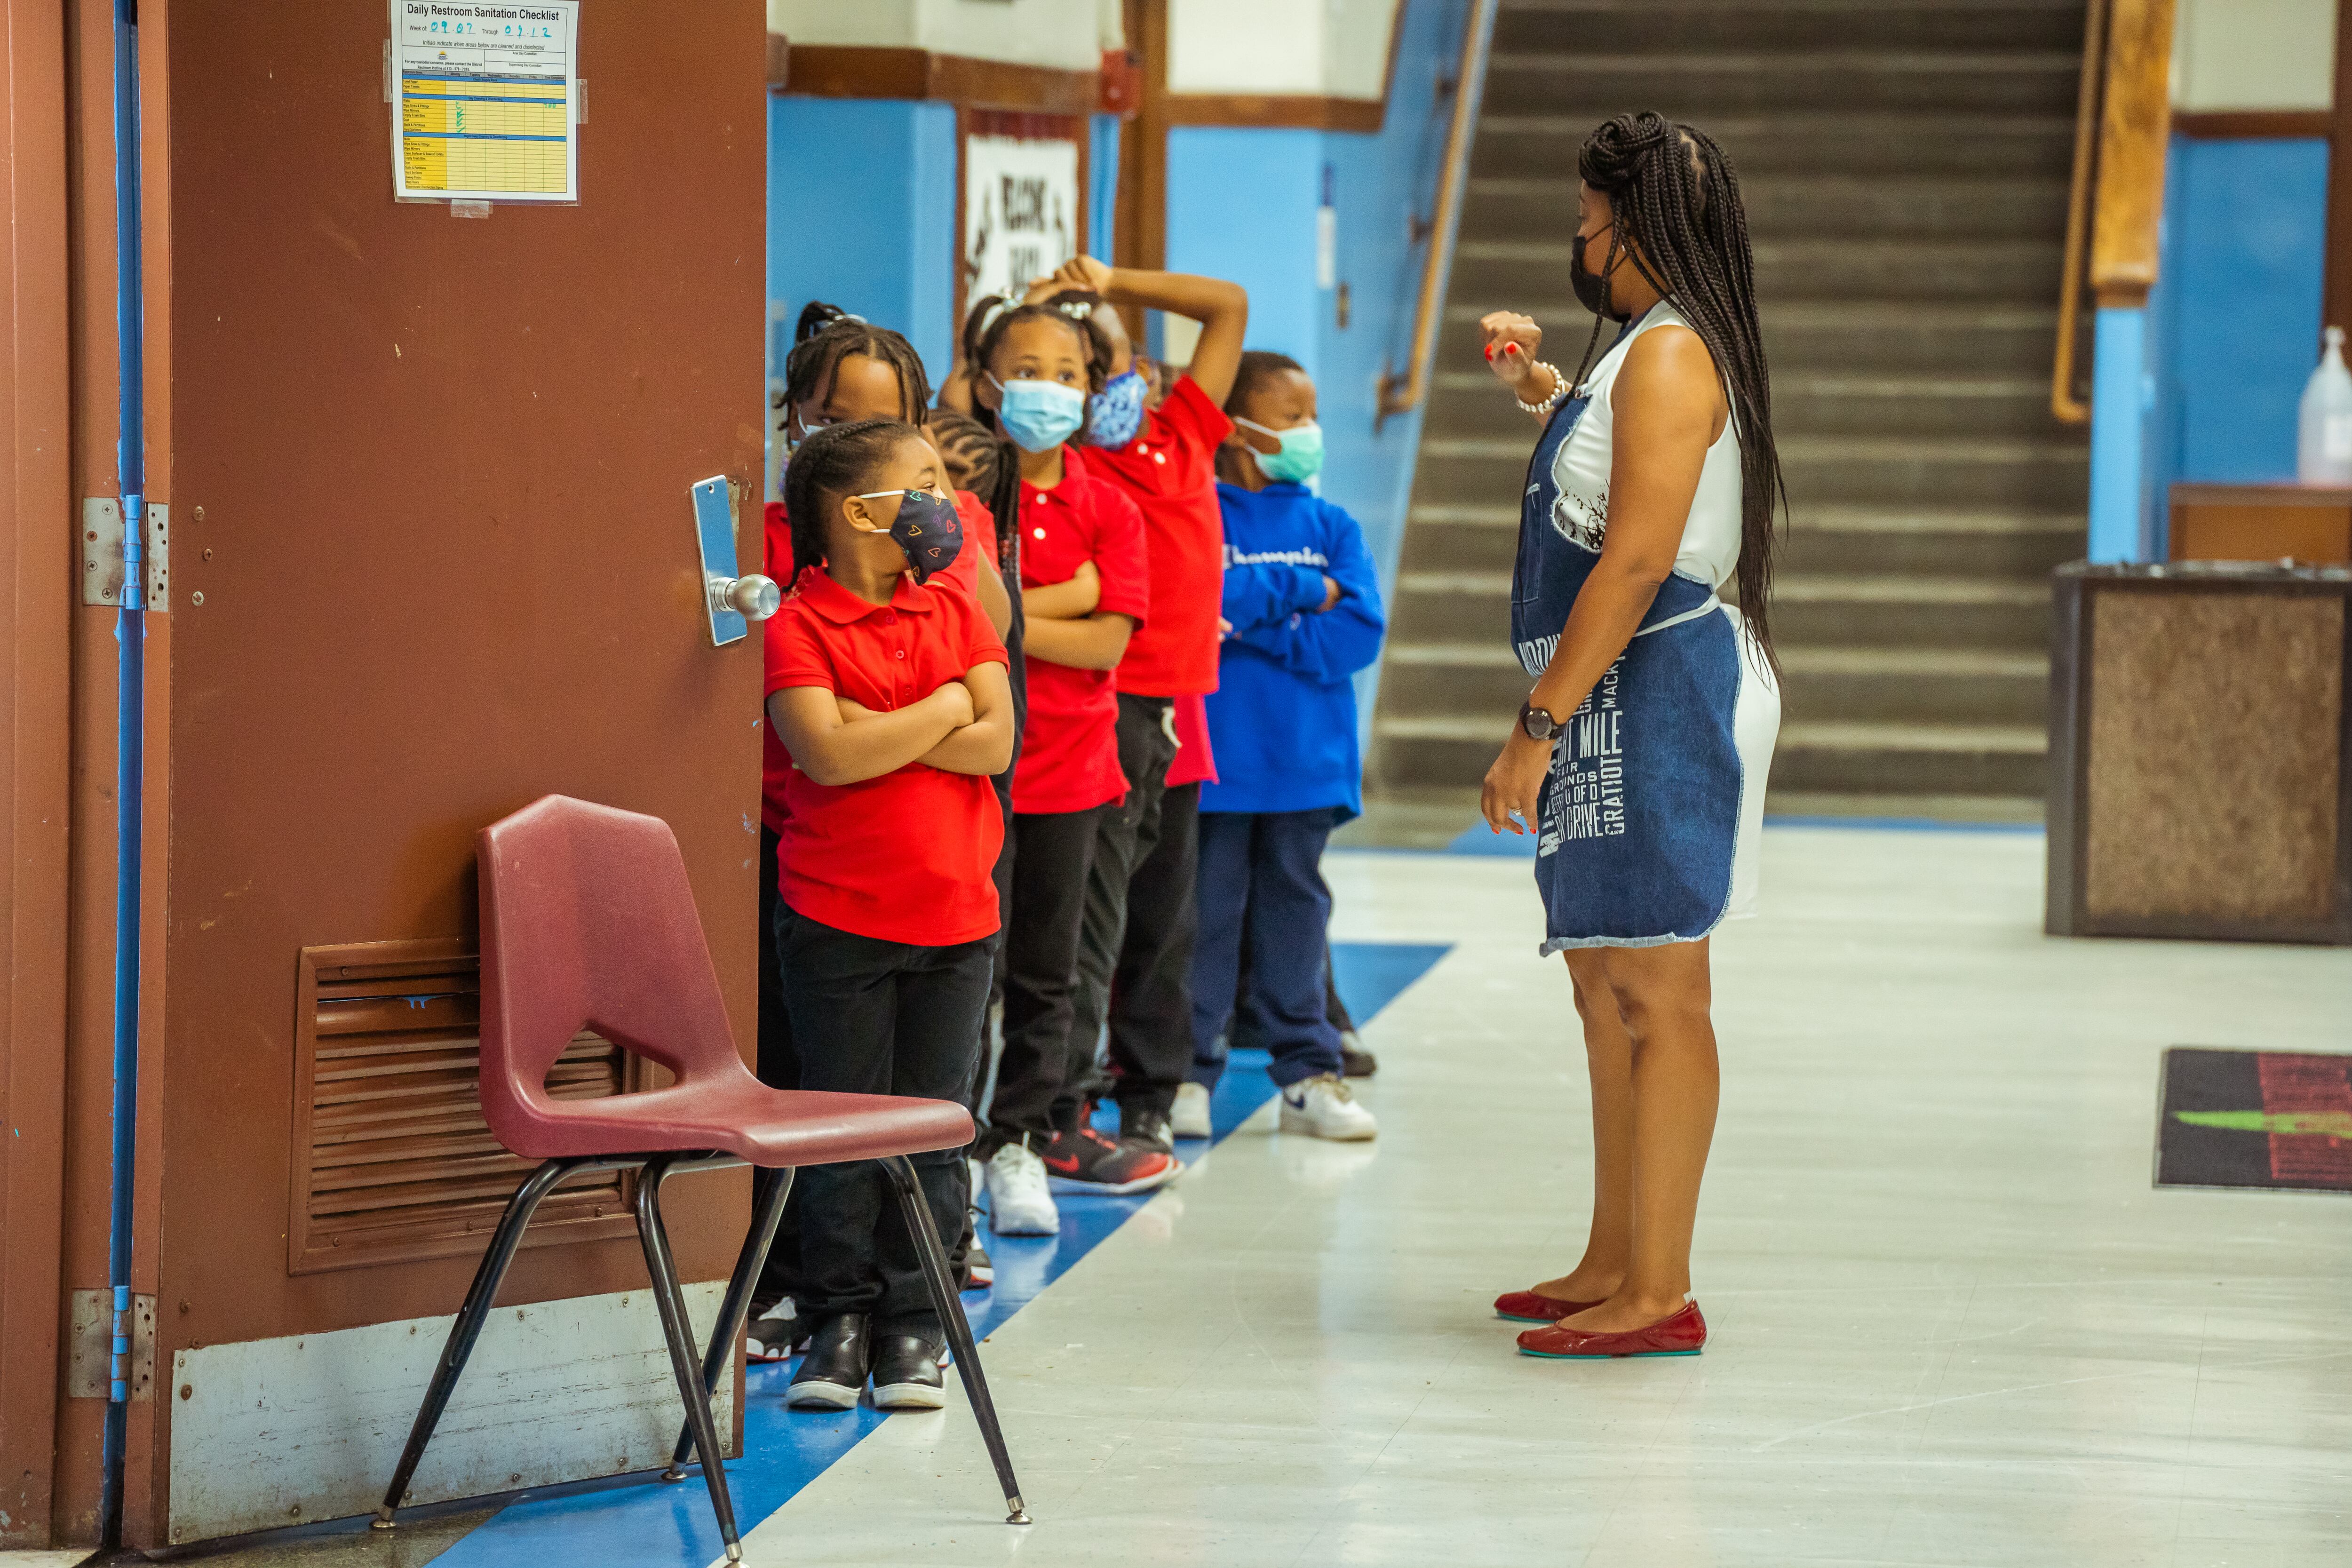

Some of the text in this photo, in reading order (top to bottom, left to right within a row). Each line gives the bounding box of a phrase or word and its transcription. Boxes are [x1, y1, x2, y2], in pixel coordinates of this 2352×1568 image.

[407, 4, 559, 20] Daily Restroom Sanitation Checklist
[1580, 710, 1623, 758] MILE
[1549, 771, 1597, 795] GROUNDS
[1557, 762, 1578, 780] FAIR
[1573, 785, 1587, 803] OF
[1590, 783, 1598, 800] D
[1600, 756, 1625, 836] GRATIOT
[1566, 802, 1604, 840] DRIVE
